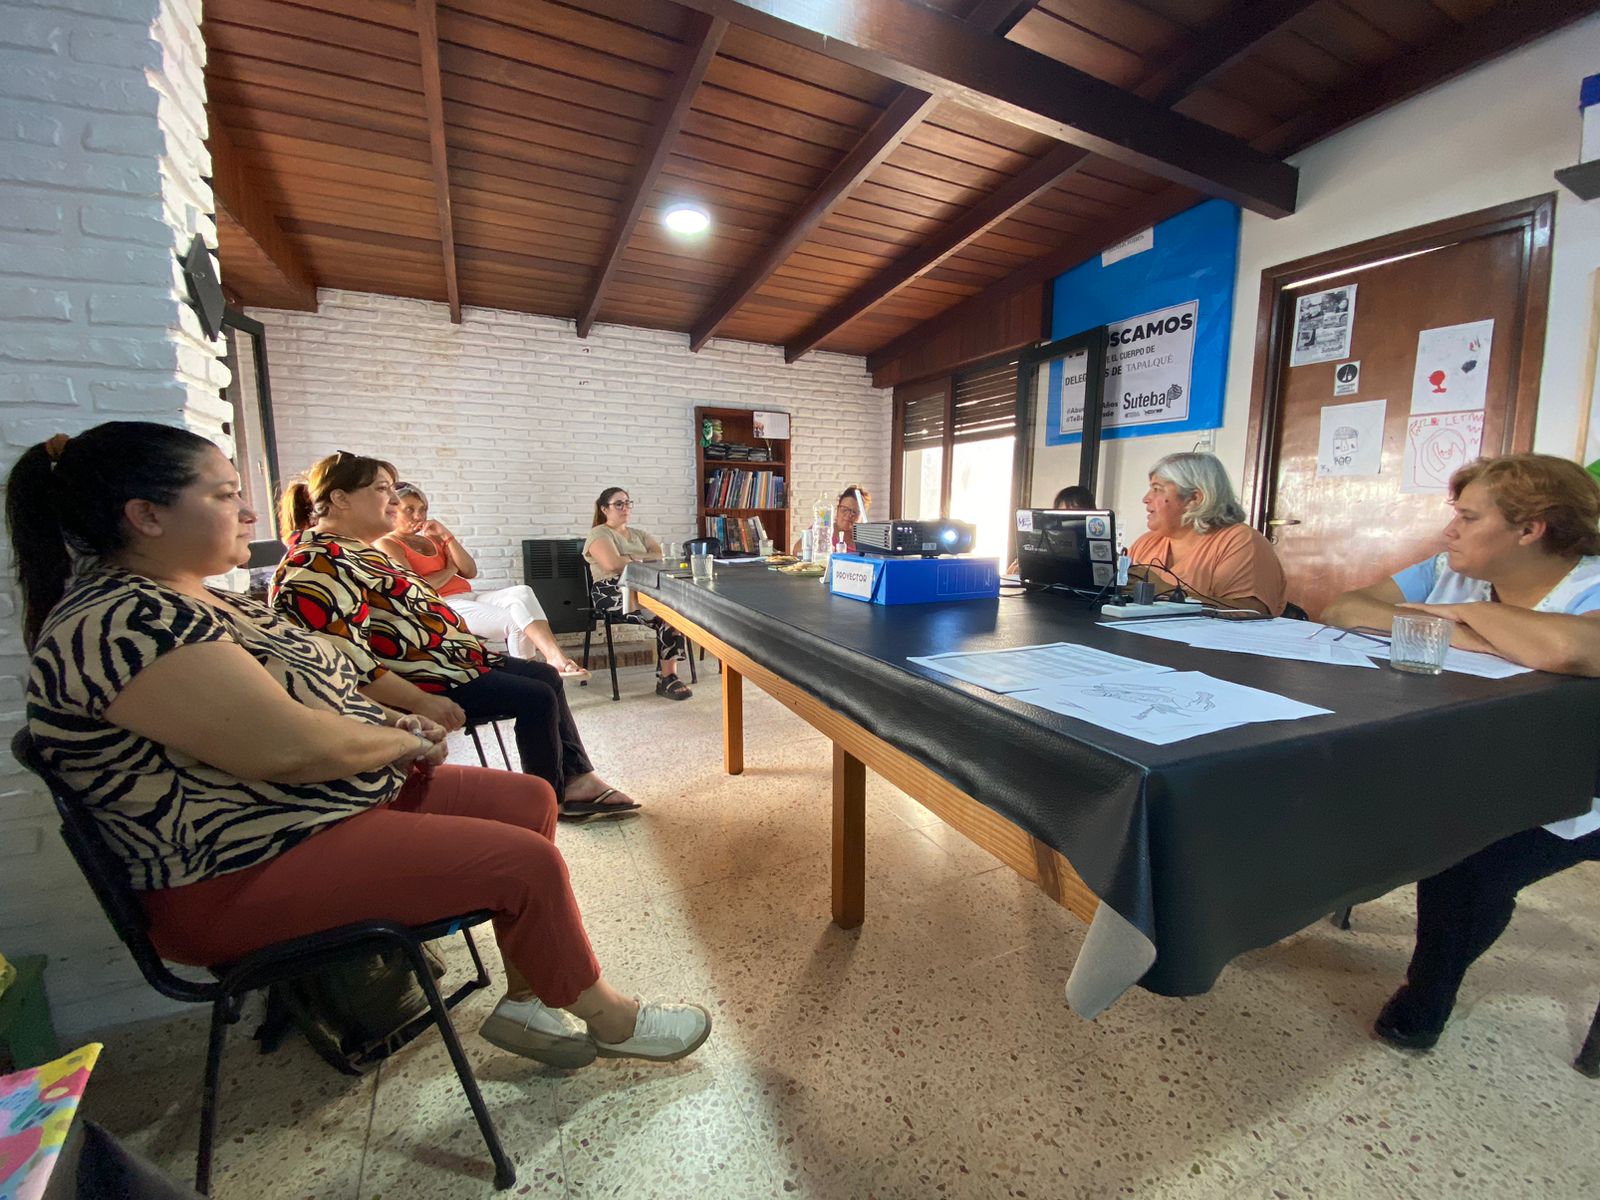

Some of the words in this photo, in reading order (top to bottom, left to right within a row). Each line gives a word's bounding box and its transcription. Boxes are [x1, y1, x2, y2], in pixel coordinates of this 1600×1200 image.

[1108, 312, 1193, 348] SCAMOS
[1119, 347, 1145, 361] CUERPO
[1146, 344, 1156, 354] DE
[1111, 365, 1123, 377] DE
[1123, 390, 1166, 411] Suteba
[836, 570, 867, 583] PROYECTOR
